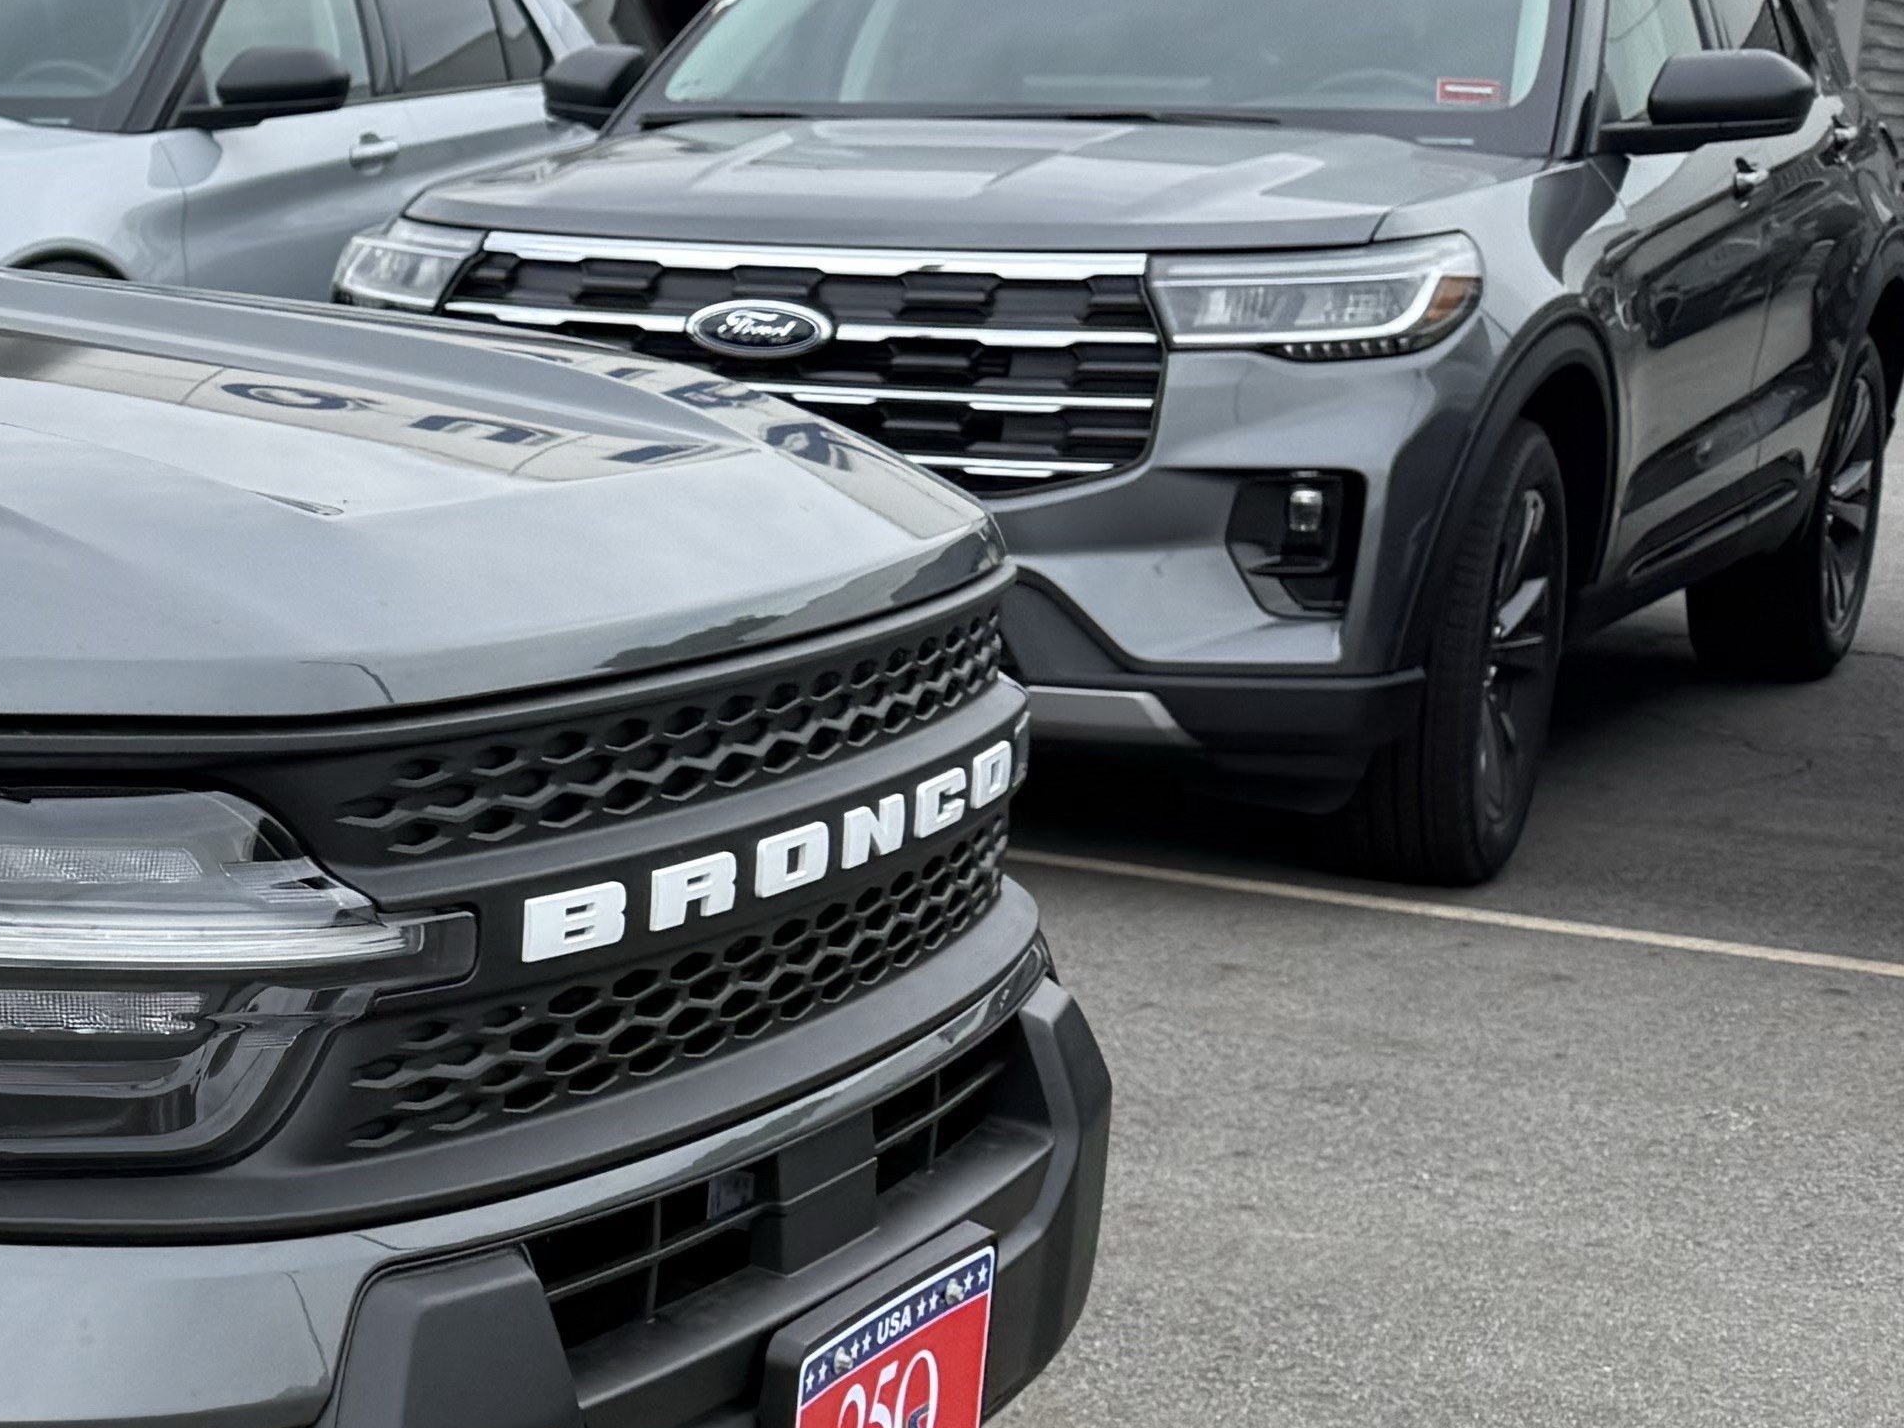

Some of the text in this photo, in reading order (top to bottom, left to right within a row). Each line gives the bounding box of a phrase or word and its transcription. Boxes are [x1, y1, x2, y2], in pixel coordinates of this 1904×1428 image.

[717, 310, 796, 342] Ford
[521, 740, 1012, 963] BRONCO
[876, 1305, 911, 1345] USA
